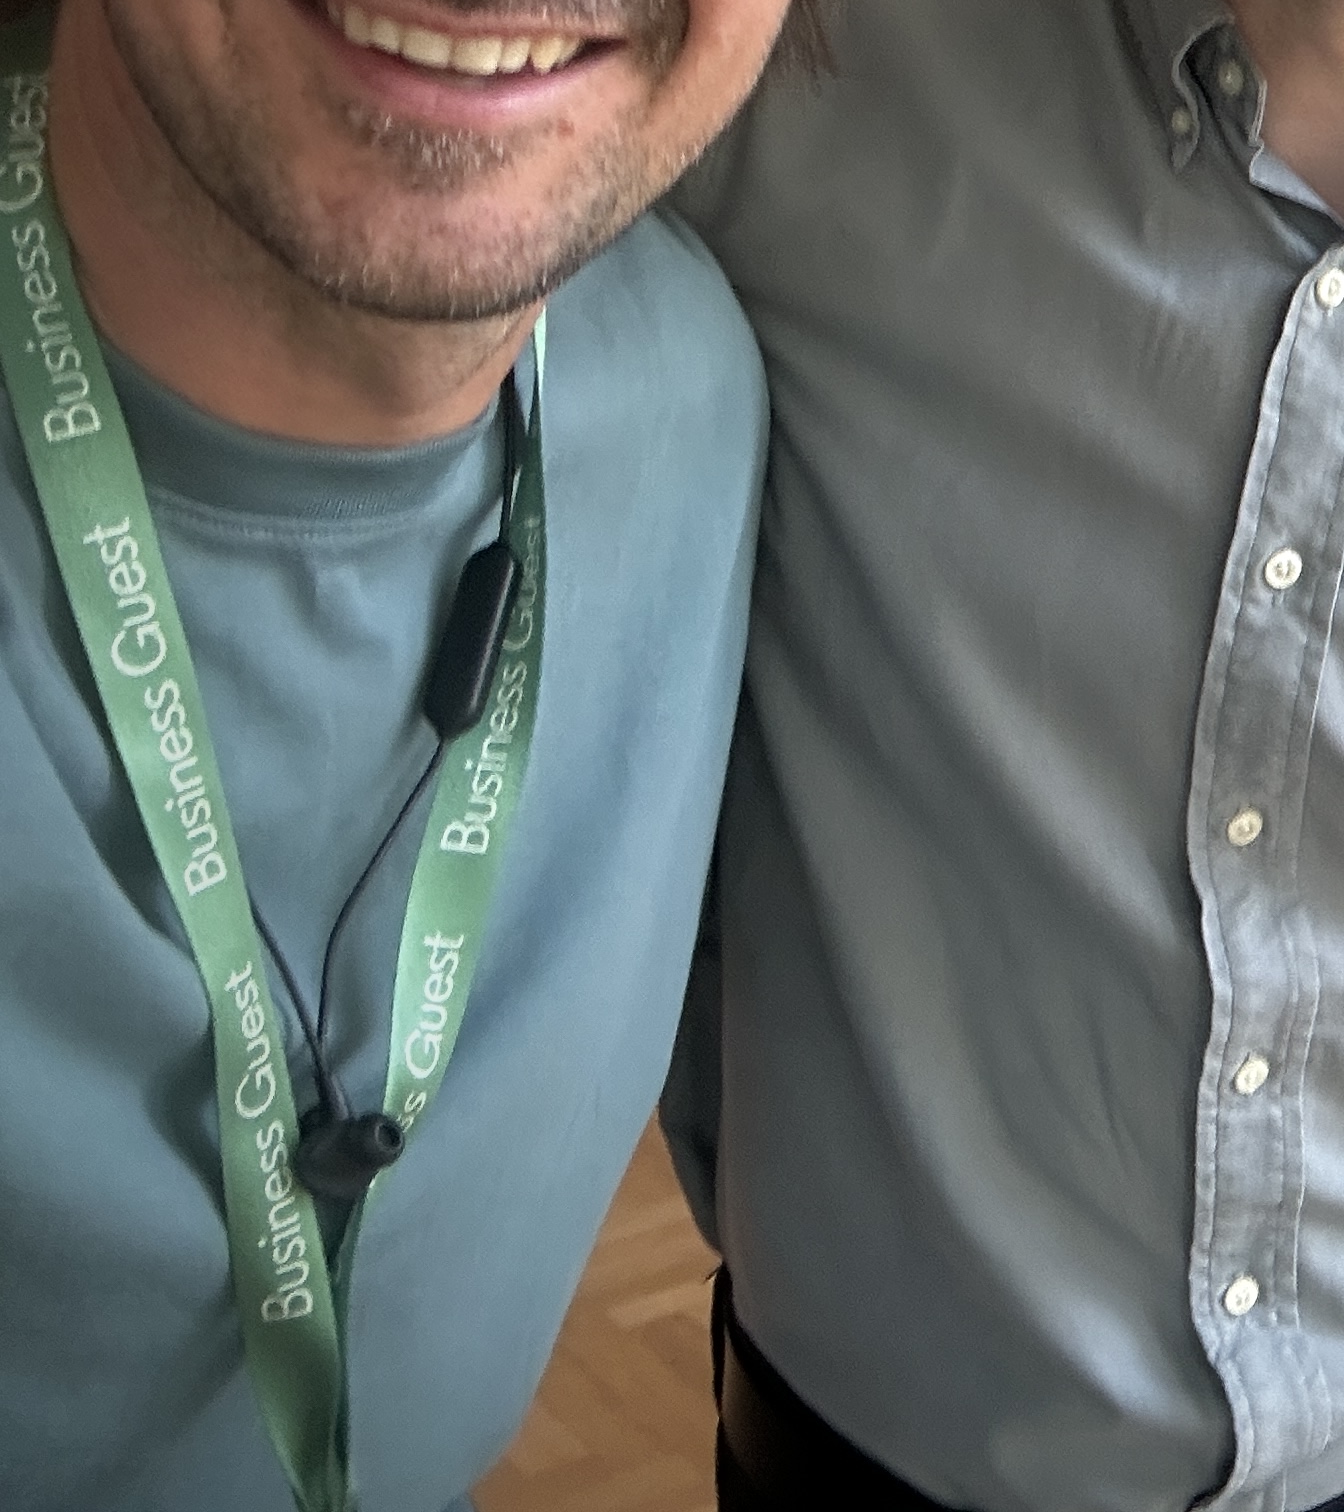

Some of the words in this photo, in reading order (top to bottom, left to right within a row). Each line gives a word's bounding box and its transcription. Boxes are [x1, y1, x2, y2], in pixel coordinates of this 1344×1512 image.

[11, 219, 101, 443] Business
[83, 516, 167, 677] Guest
[145, 678, 227, 896] Business
[440, 661, 527, 854] Business
[225, 961, 276, 1120] Guest
[405, 930, 464, 1079] Guest
[256, 1119, 313, 1323] Business
